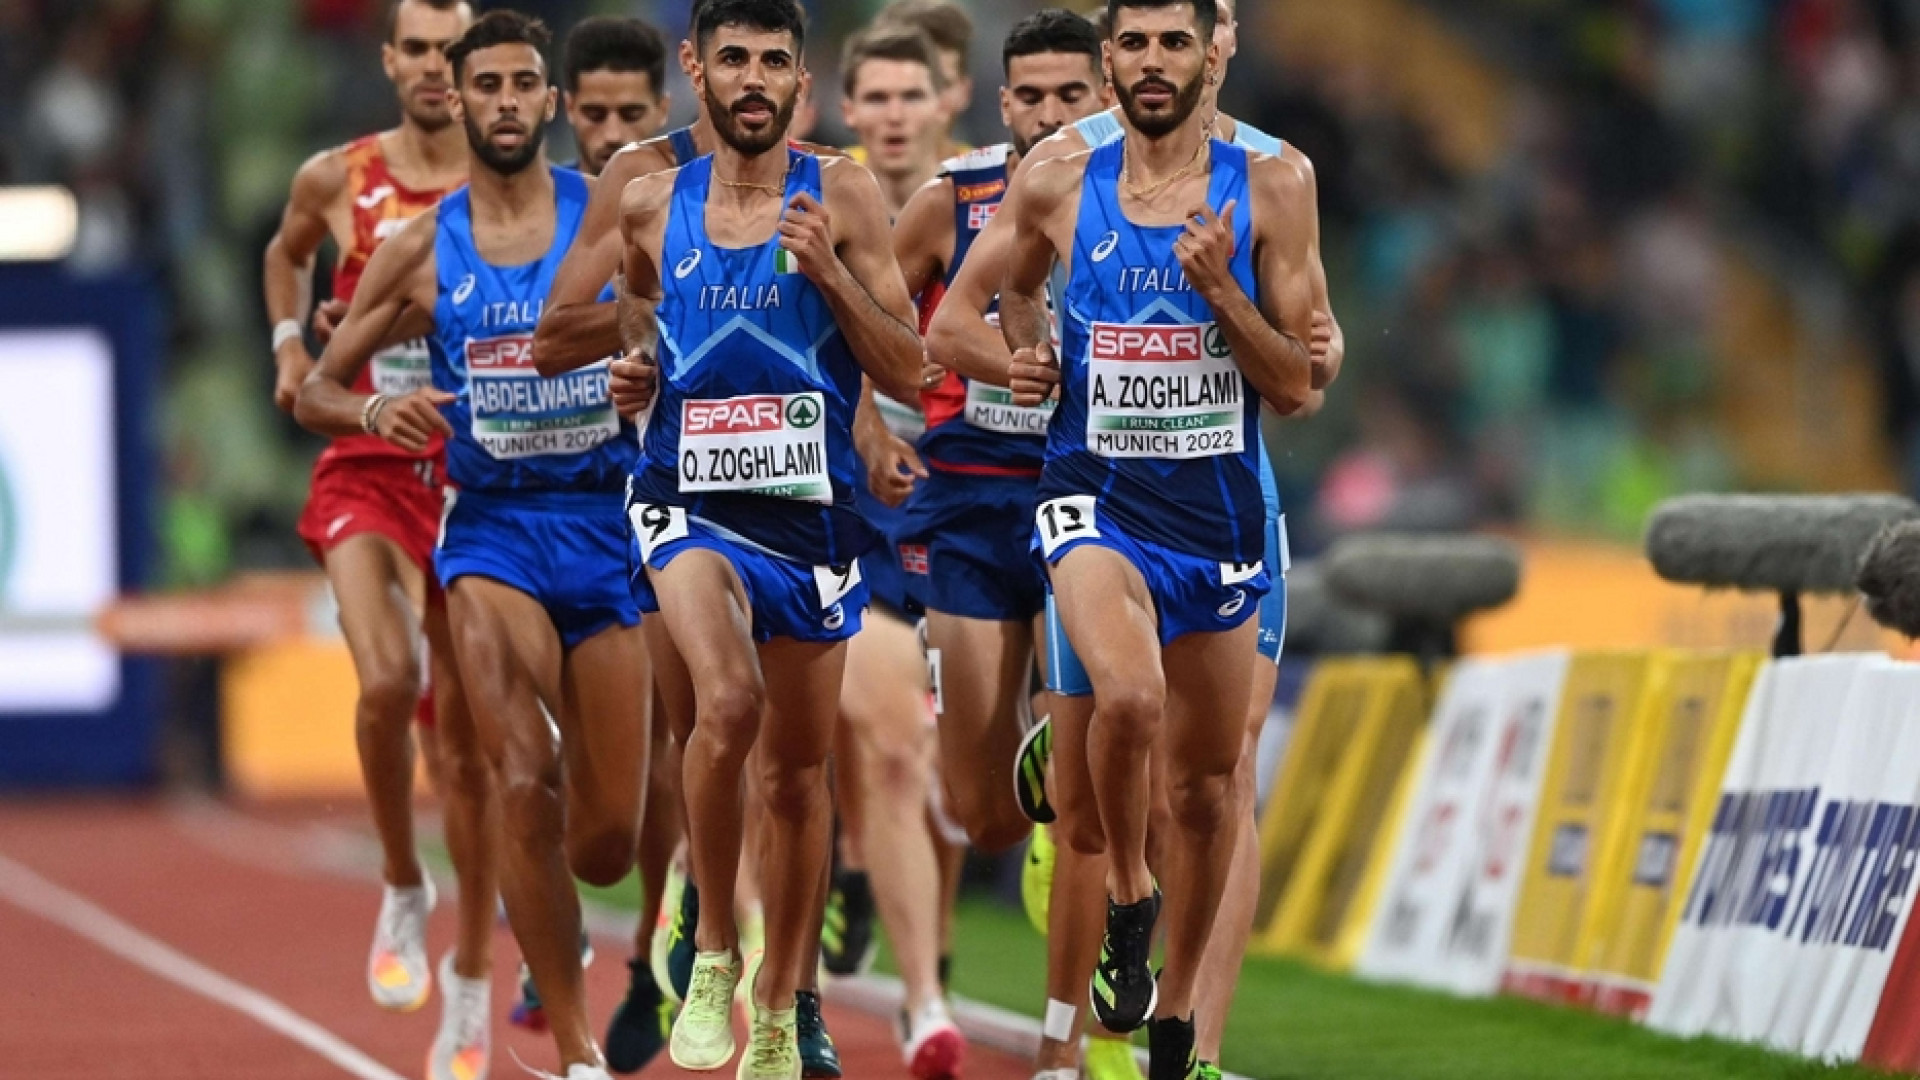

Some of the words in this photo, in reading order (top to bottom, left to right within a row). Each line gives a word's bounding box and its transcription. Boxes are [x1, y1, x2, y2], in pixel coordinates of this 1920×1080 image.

[1118, 266, 1191, 292] ITALI
[699, 283, 780, 310] ITALIA
[472, 341, 533, 365] SPA
[1095, 330, 1198, 357] SPAR
[475, 372, 609, 413] ABDELWAHED
[1091, 373, 1113, 408] A.
[1117, 370, 1238, 410] ZOGHLAMI
[687, 402, 780, 431] SPAR
[1130, 417, 1158, 429] RUN
[482, 432, 558, 453] MUNICH
[1097, 433, 1179, 453] MUNICH
[1185, 430, 1234, 451] 2022
[682, 449, 704, 482] O.
[708, 441, 822, 482] ZOGHLAMI
[641, 504, 671, 543] 9
